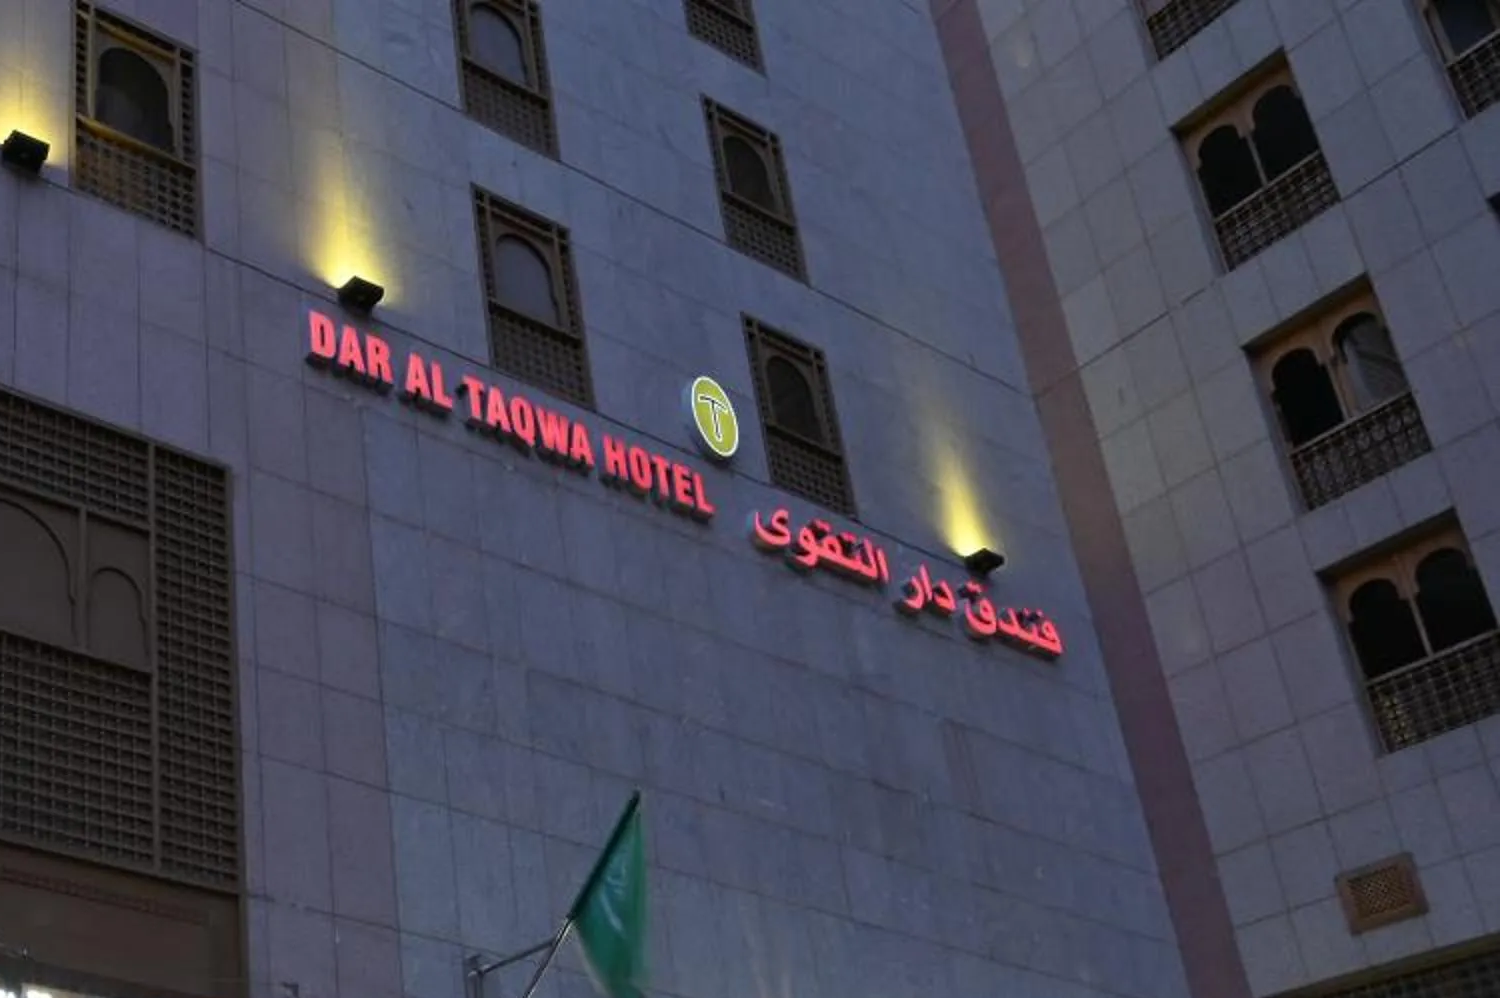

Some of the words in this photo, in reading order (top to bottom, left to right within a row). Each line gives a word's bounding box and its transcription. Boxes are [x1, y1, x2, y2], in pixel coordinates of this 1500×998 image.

[309, 310, 393, 383] DAR
[405, 352, 453, 408] AL
[463, 375, 595, 467] TAQWA
[603, 433, 715, 514] HOTEL
[754, 506, 889, 584] التقوى
[902, 560, 957, 612] دار
[964, 580, 1064, 655] فندق
